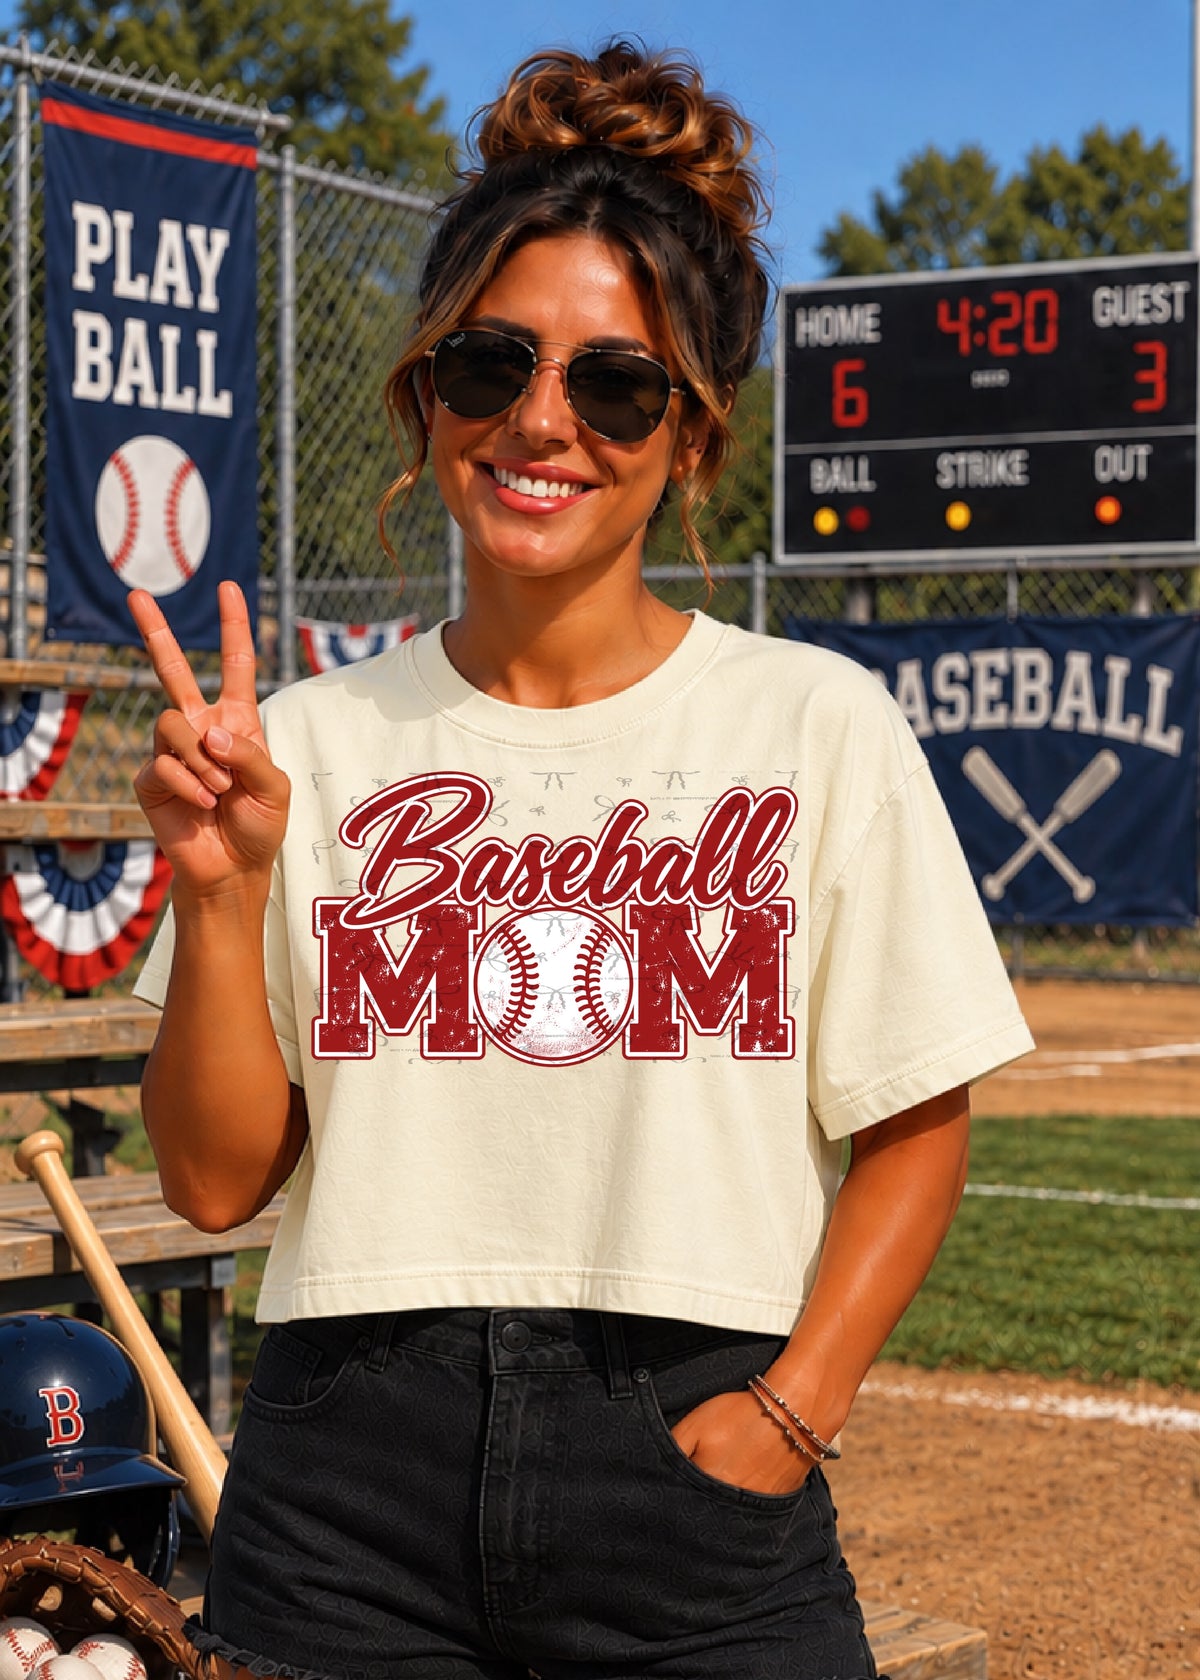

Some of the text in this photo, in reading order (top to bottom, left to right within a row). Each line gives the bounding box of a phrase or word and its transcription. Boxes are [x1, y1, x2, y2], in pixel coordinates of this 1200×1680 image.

[72, 201, 230, 312] PLAY
[795, 303, 882, 347] HOME
[937, 289, 1059, 356] 4:20
[1092, 282, 1190, 327] GUEST
[72, 309, 232, 418] BALL
[832, 359, 868, 428] 6
[1133, 341, 1168, 413] 3
[810, 455, 877, 493] BALL
[936, 449, 1030, 489] STRIKE
[1094, 445, 1153, 483] OUT
[869, 647, 1184, 758] ASEBALL
[338, 771, 798, 930] Baseball
[39, 1386, 85, 1447] B
